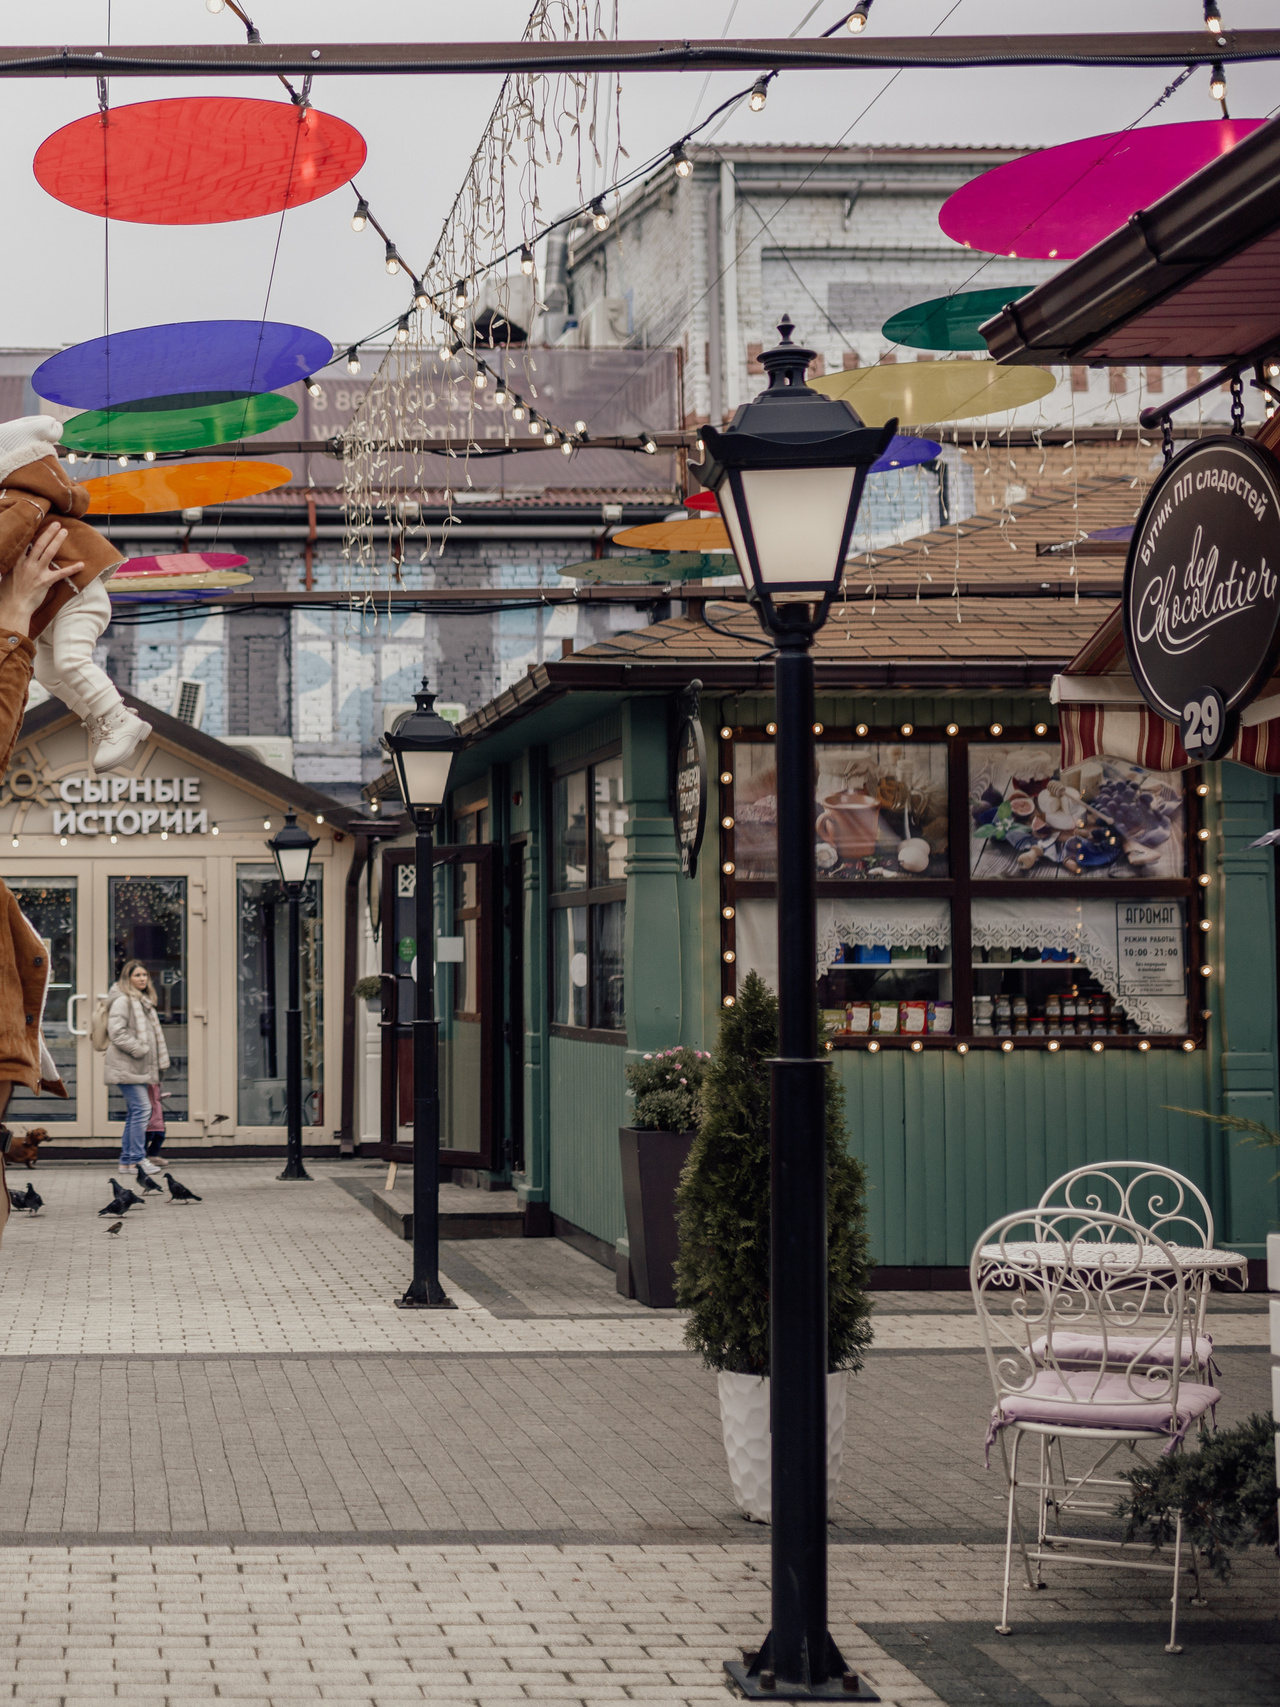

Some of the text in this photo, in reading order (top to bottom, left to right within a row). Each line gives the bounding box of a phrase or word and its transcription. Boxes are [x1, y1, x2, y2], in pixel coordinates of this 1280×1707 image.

[1140, 468, 1269, 566] Бутик ПП сладостей
[1137, 547, 1278, 655] Chocolatier
[1183, 695, 1220, 750] 29
[59, 777, 201, 803] СЫРНЫЕ
[52, 808, 208, 835] ИСТОРИИ
[1125, 907, 1175, 924] АГРОМАГ
[1124, 948, 1148, 957] 10:00
[1154, 948, 1178, 957] 21:00
